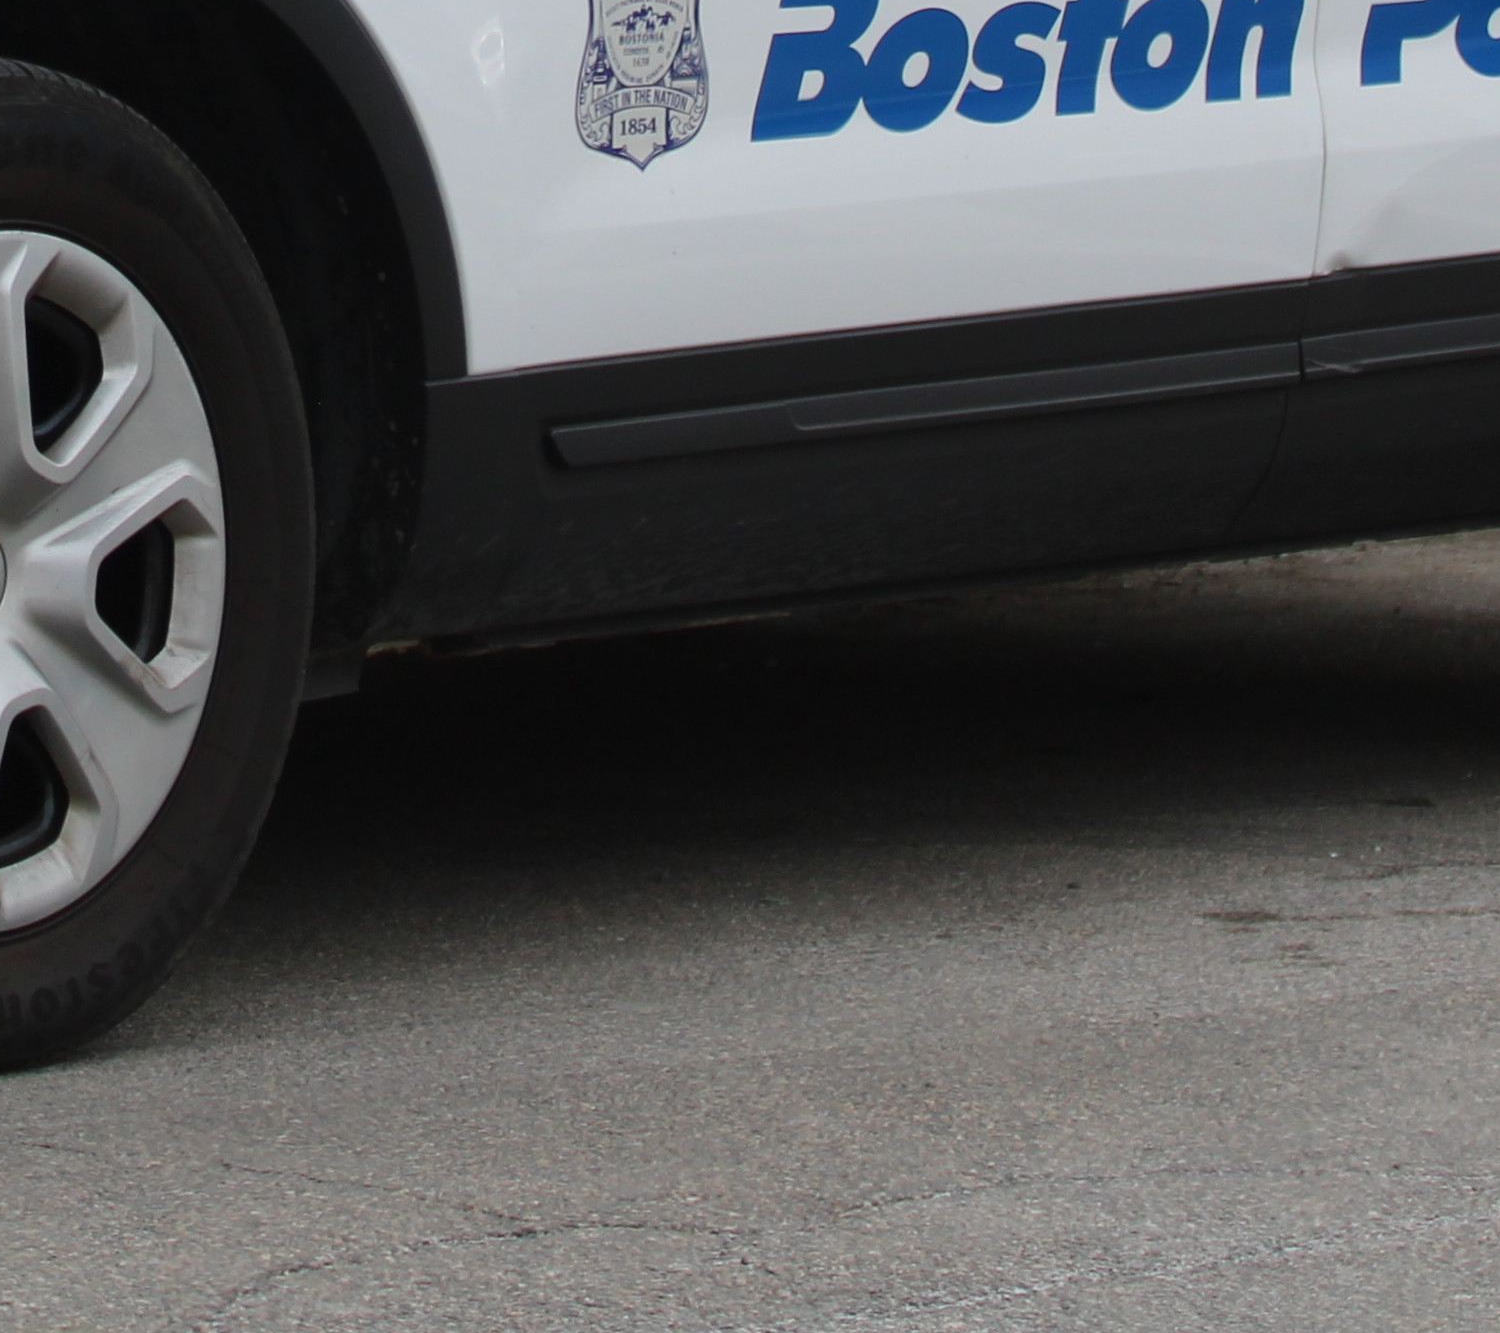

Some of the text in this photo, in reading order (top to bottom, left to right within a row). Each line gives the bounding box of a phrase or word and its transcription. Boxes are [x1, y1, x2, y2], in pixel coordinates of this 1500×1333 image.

[594, 89, 689, 115] FIRST IN THE NATION
[620, 117, 657, 136] 1854
